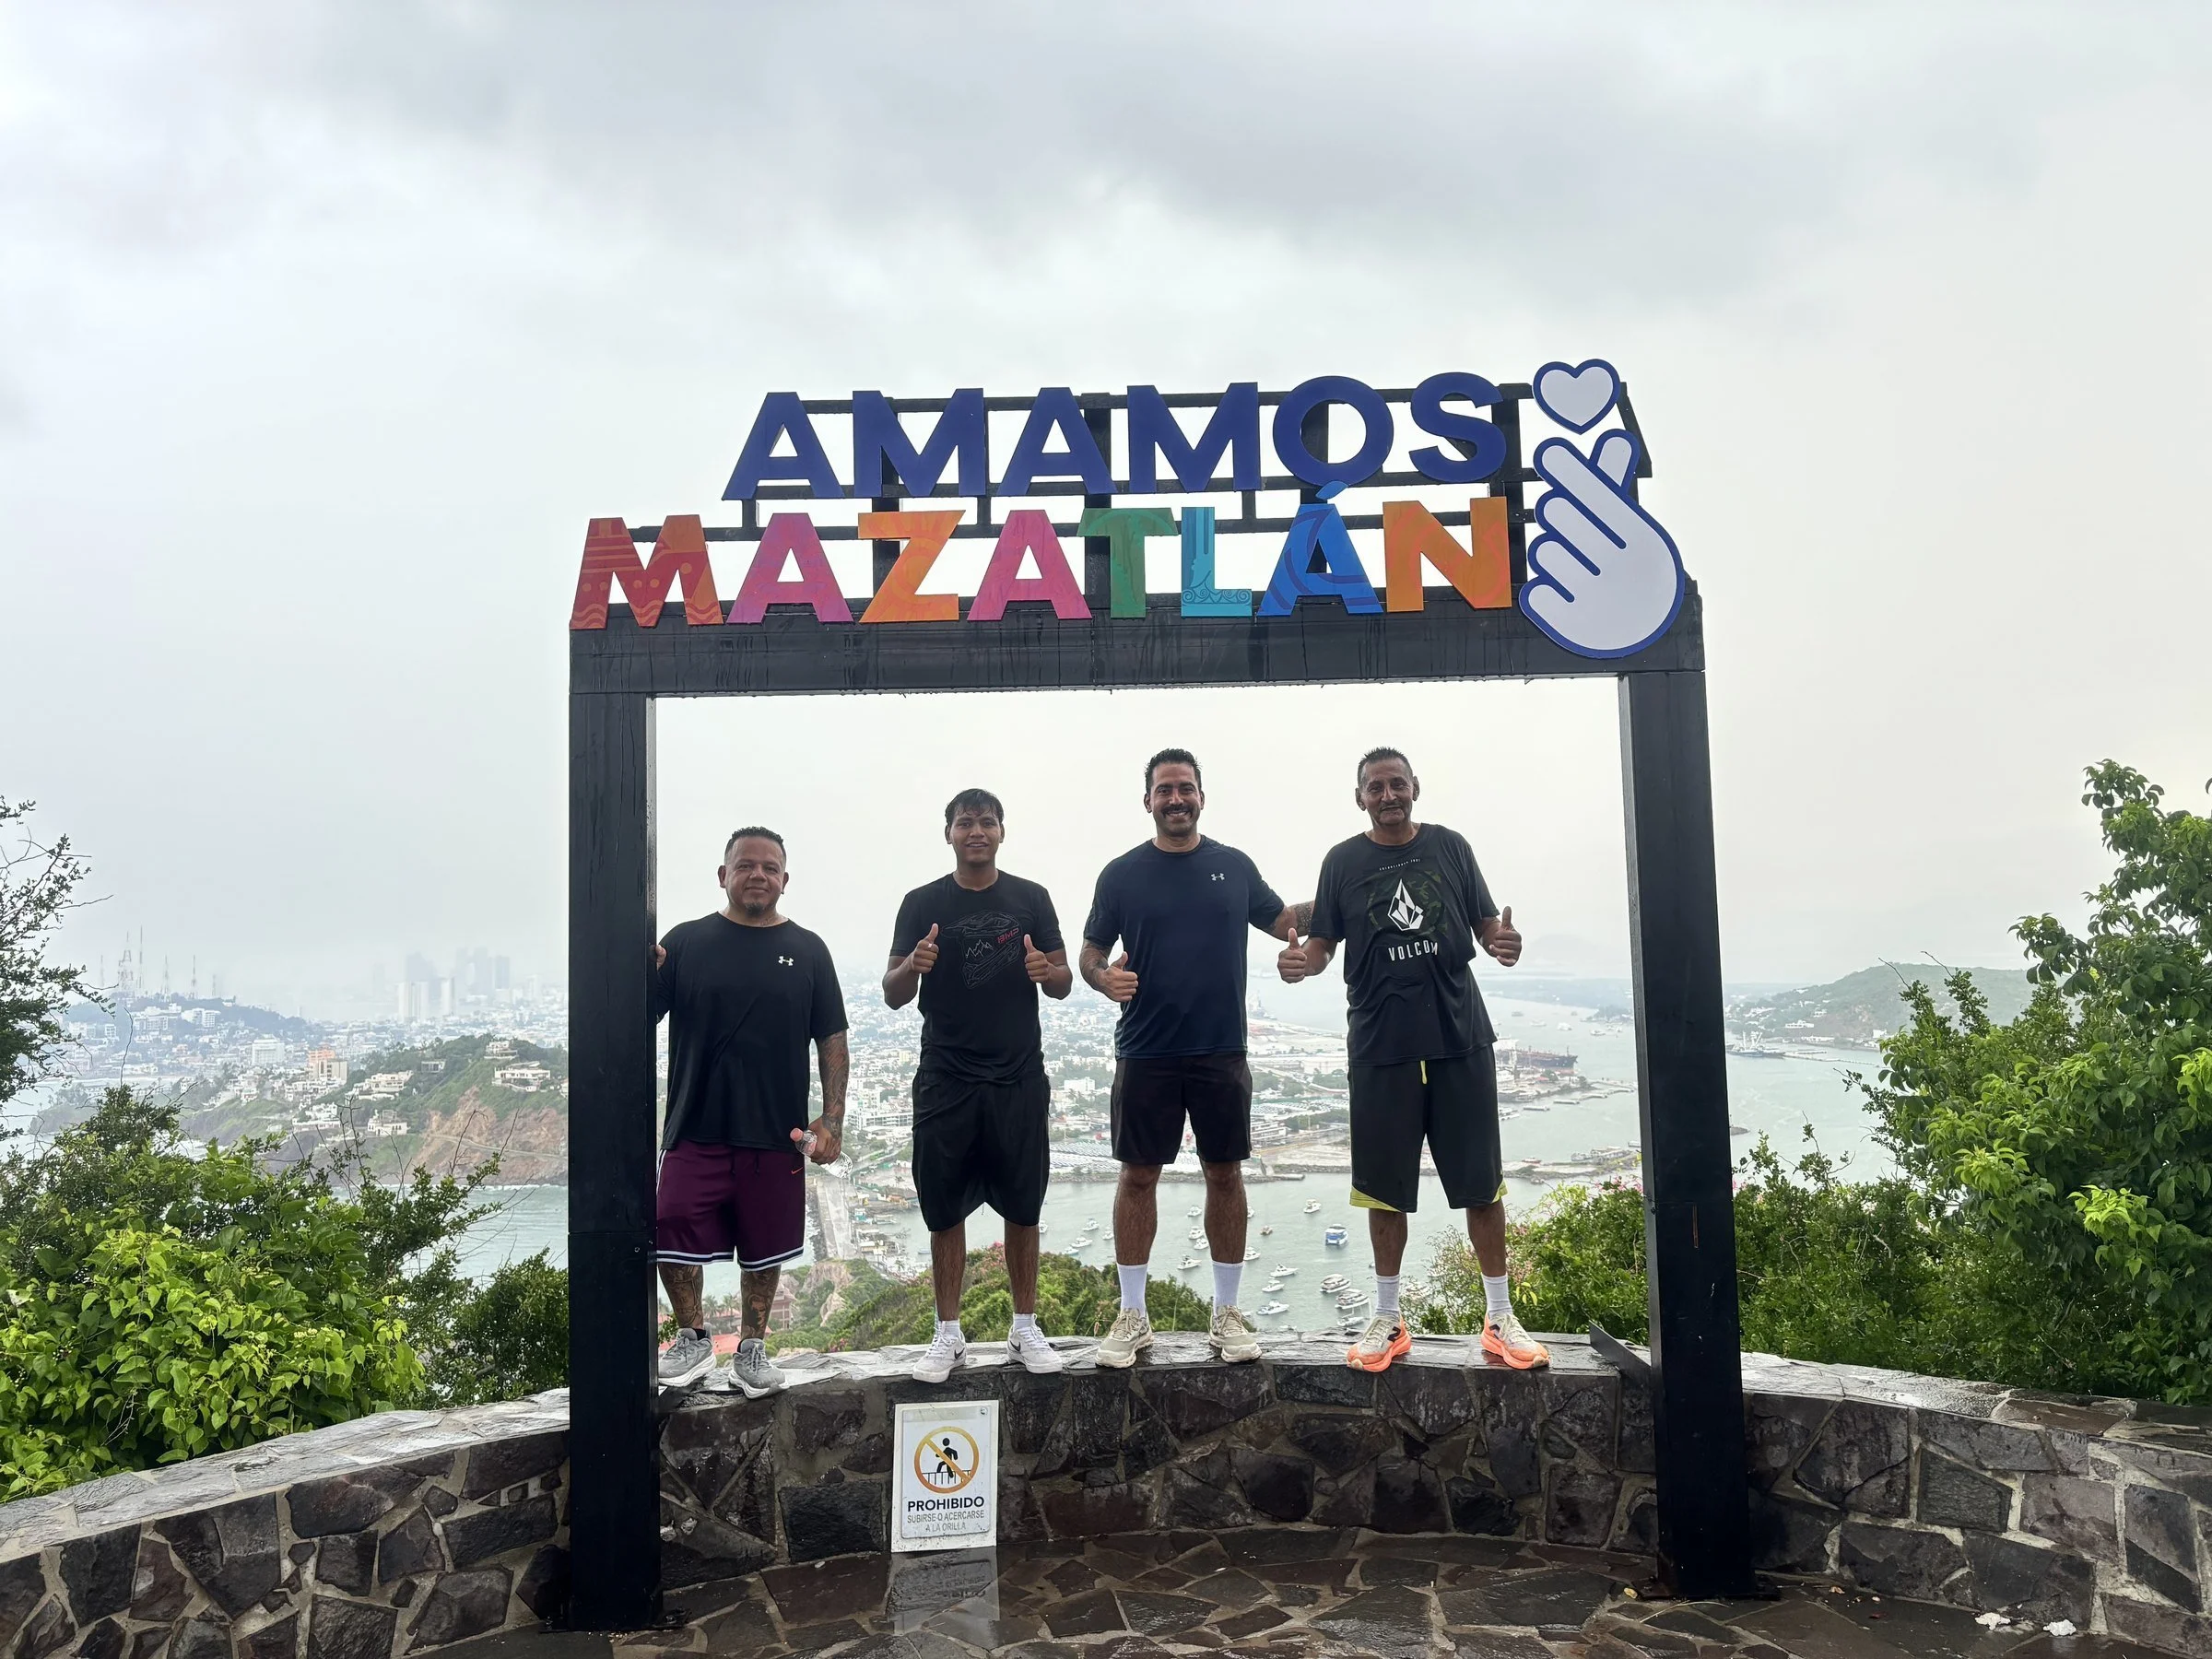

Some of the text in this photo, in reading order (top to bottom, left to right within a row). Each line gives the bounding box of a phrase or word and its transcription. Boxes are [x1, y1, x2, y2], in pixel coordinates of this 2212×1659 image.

[721, 371, 1507, 500] AMAMOS
[569, 479, 1512, 629] MAZATLÁN
[908, 1496, 984, 1512] PROHIBIDO
[907, 1510, 984, 1524] SUBIRSE O ACERCARSE
[925, 1522, 966, 1532] A LA ORILLA
